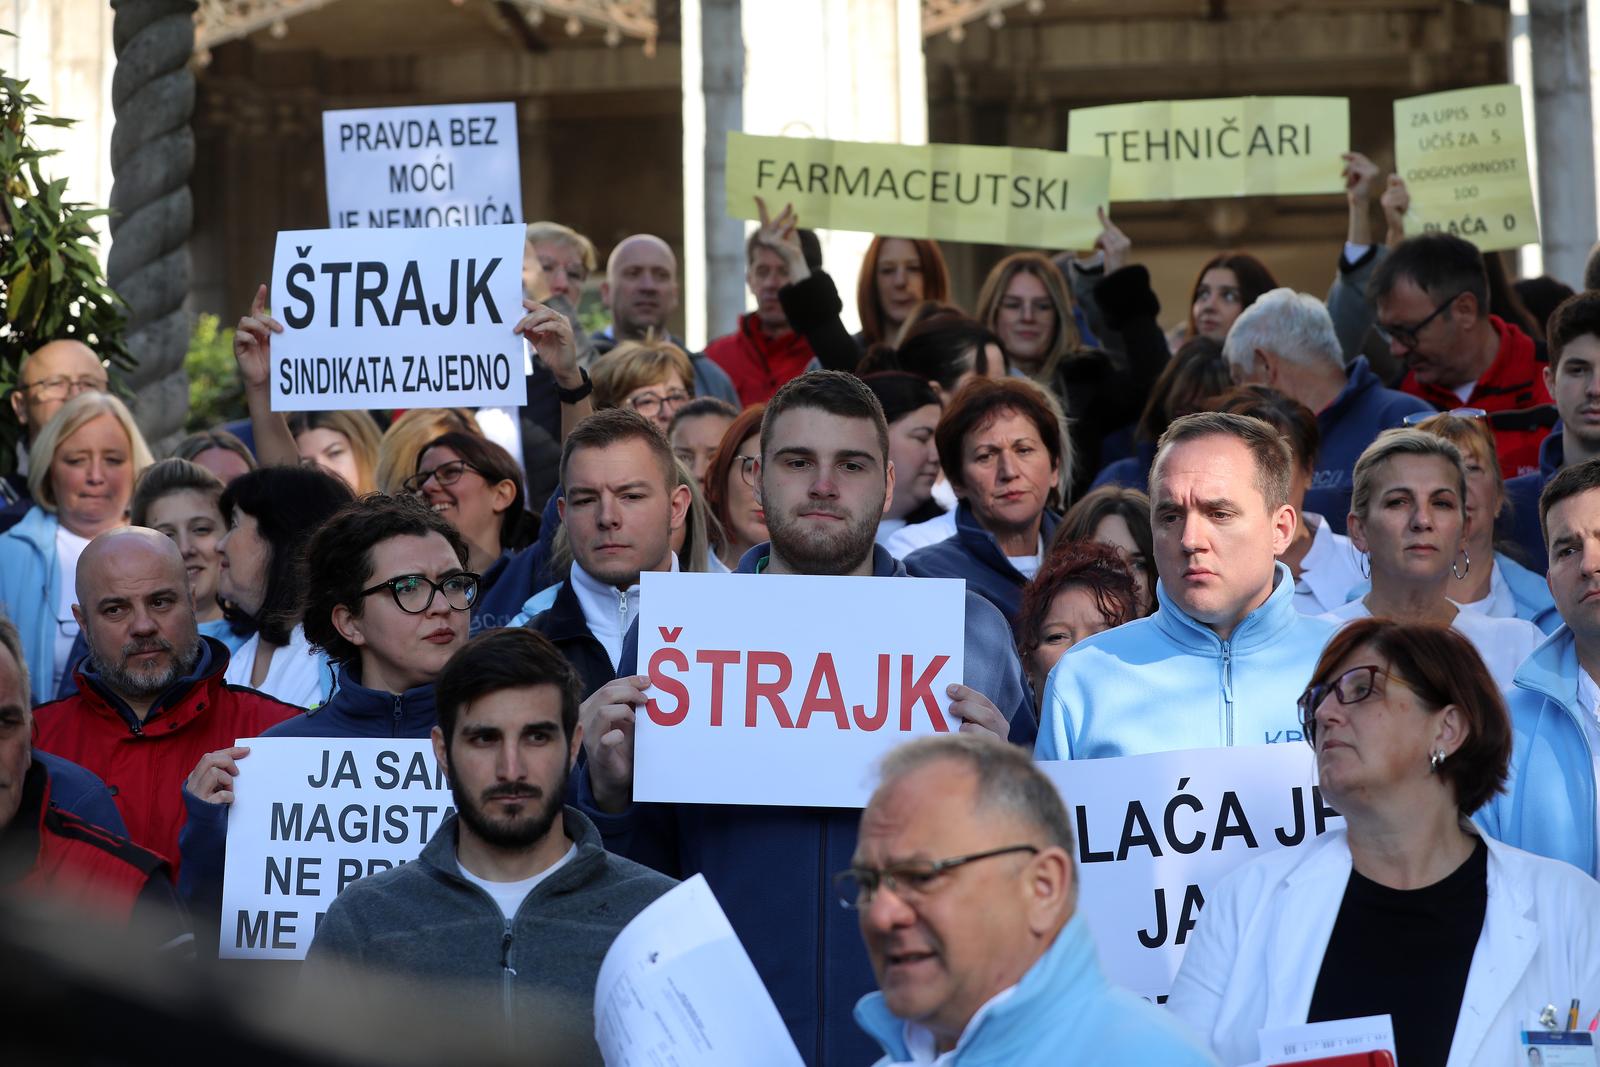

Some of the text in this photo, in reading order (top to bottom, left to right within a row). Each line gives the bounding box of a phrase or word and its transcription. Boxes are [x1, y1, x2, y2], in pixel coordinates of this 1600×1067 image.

[340, 117, 499, 152] PRAVDA BEZ
[1095, 117, 1310, 162] TEHNIČARI
[389, 155, 455, 194] MOĆI
[756, 159, 1068, 211] FARMACEUTSKI
[283, 245, 503, 330] ŠTRAJK
[280, 353, 510, 395] SINDIKATA ZAJEDNO
[646, 626, 951, 733] ŠTRAJK
[308, 750, 362, 789] JA
[1075, 777, 1259, 863] LAĆA
[264, 857, 322, 896] NE
[236, 910, 298, 949] ME
